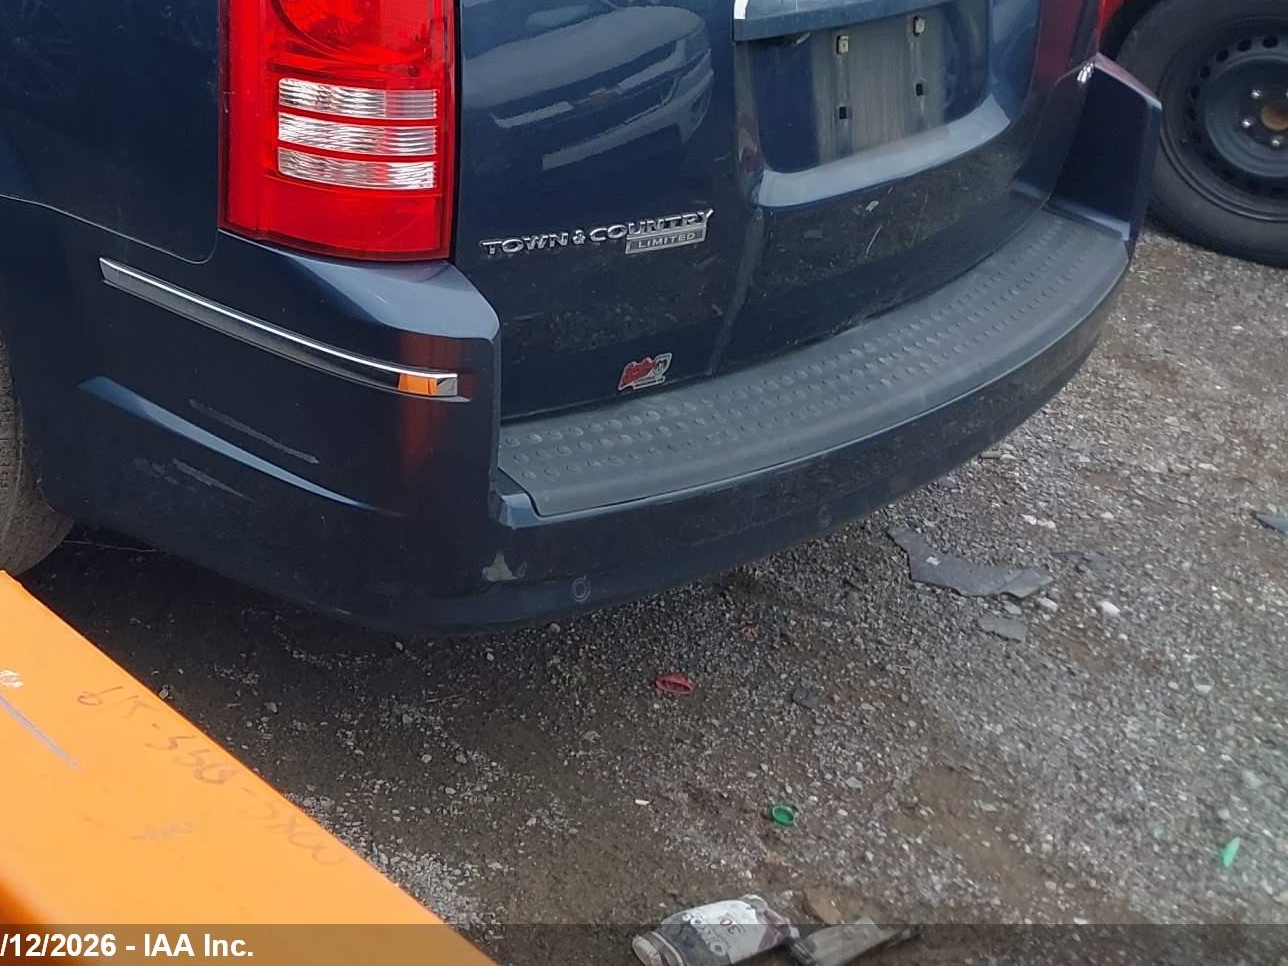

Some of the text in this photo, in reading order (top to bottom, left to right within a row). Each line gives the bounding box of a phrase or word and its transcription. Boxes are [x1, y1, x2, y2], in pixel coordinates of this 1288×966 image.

[481, 209, 714, 255] TOWN & COUNTRY
[637, 232, 696, 250] LIMITED
